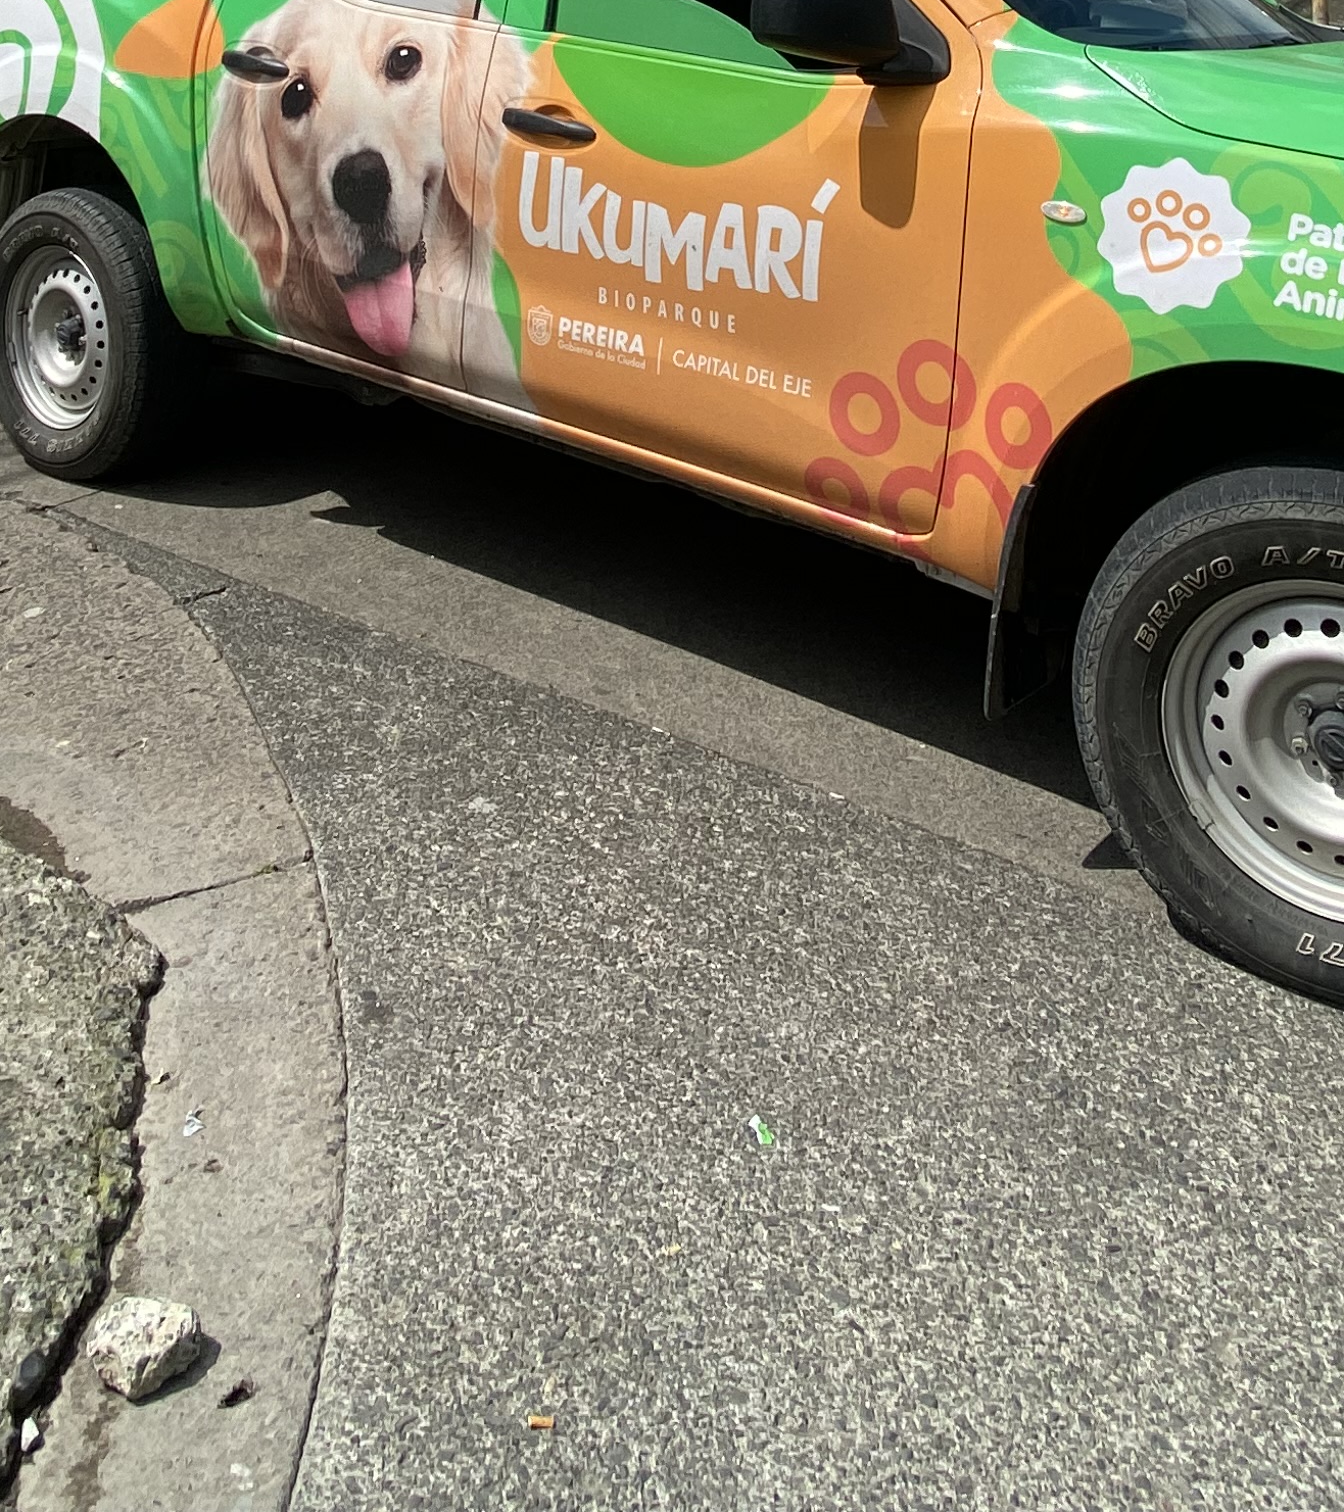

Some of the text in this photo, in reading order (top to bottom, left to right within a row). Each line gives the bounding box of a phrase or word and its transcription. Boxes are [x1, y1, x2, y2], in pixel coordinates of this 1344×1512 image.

[519, 151, 841, 302] UKUMARÍ
[1279, 248, 1328, 280] de
[598, 287, 736, 334] BIOPARQUE
[557, 339, 646, 370] Gobierno de la Ciudad
[558, 316, 645, 357] PEREIRA
[672, 349, 813, 398] CAPITAL DEL EJE
[1134, 555, 1235, 653] BRAVO
